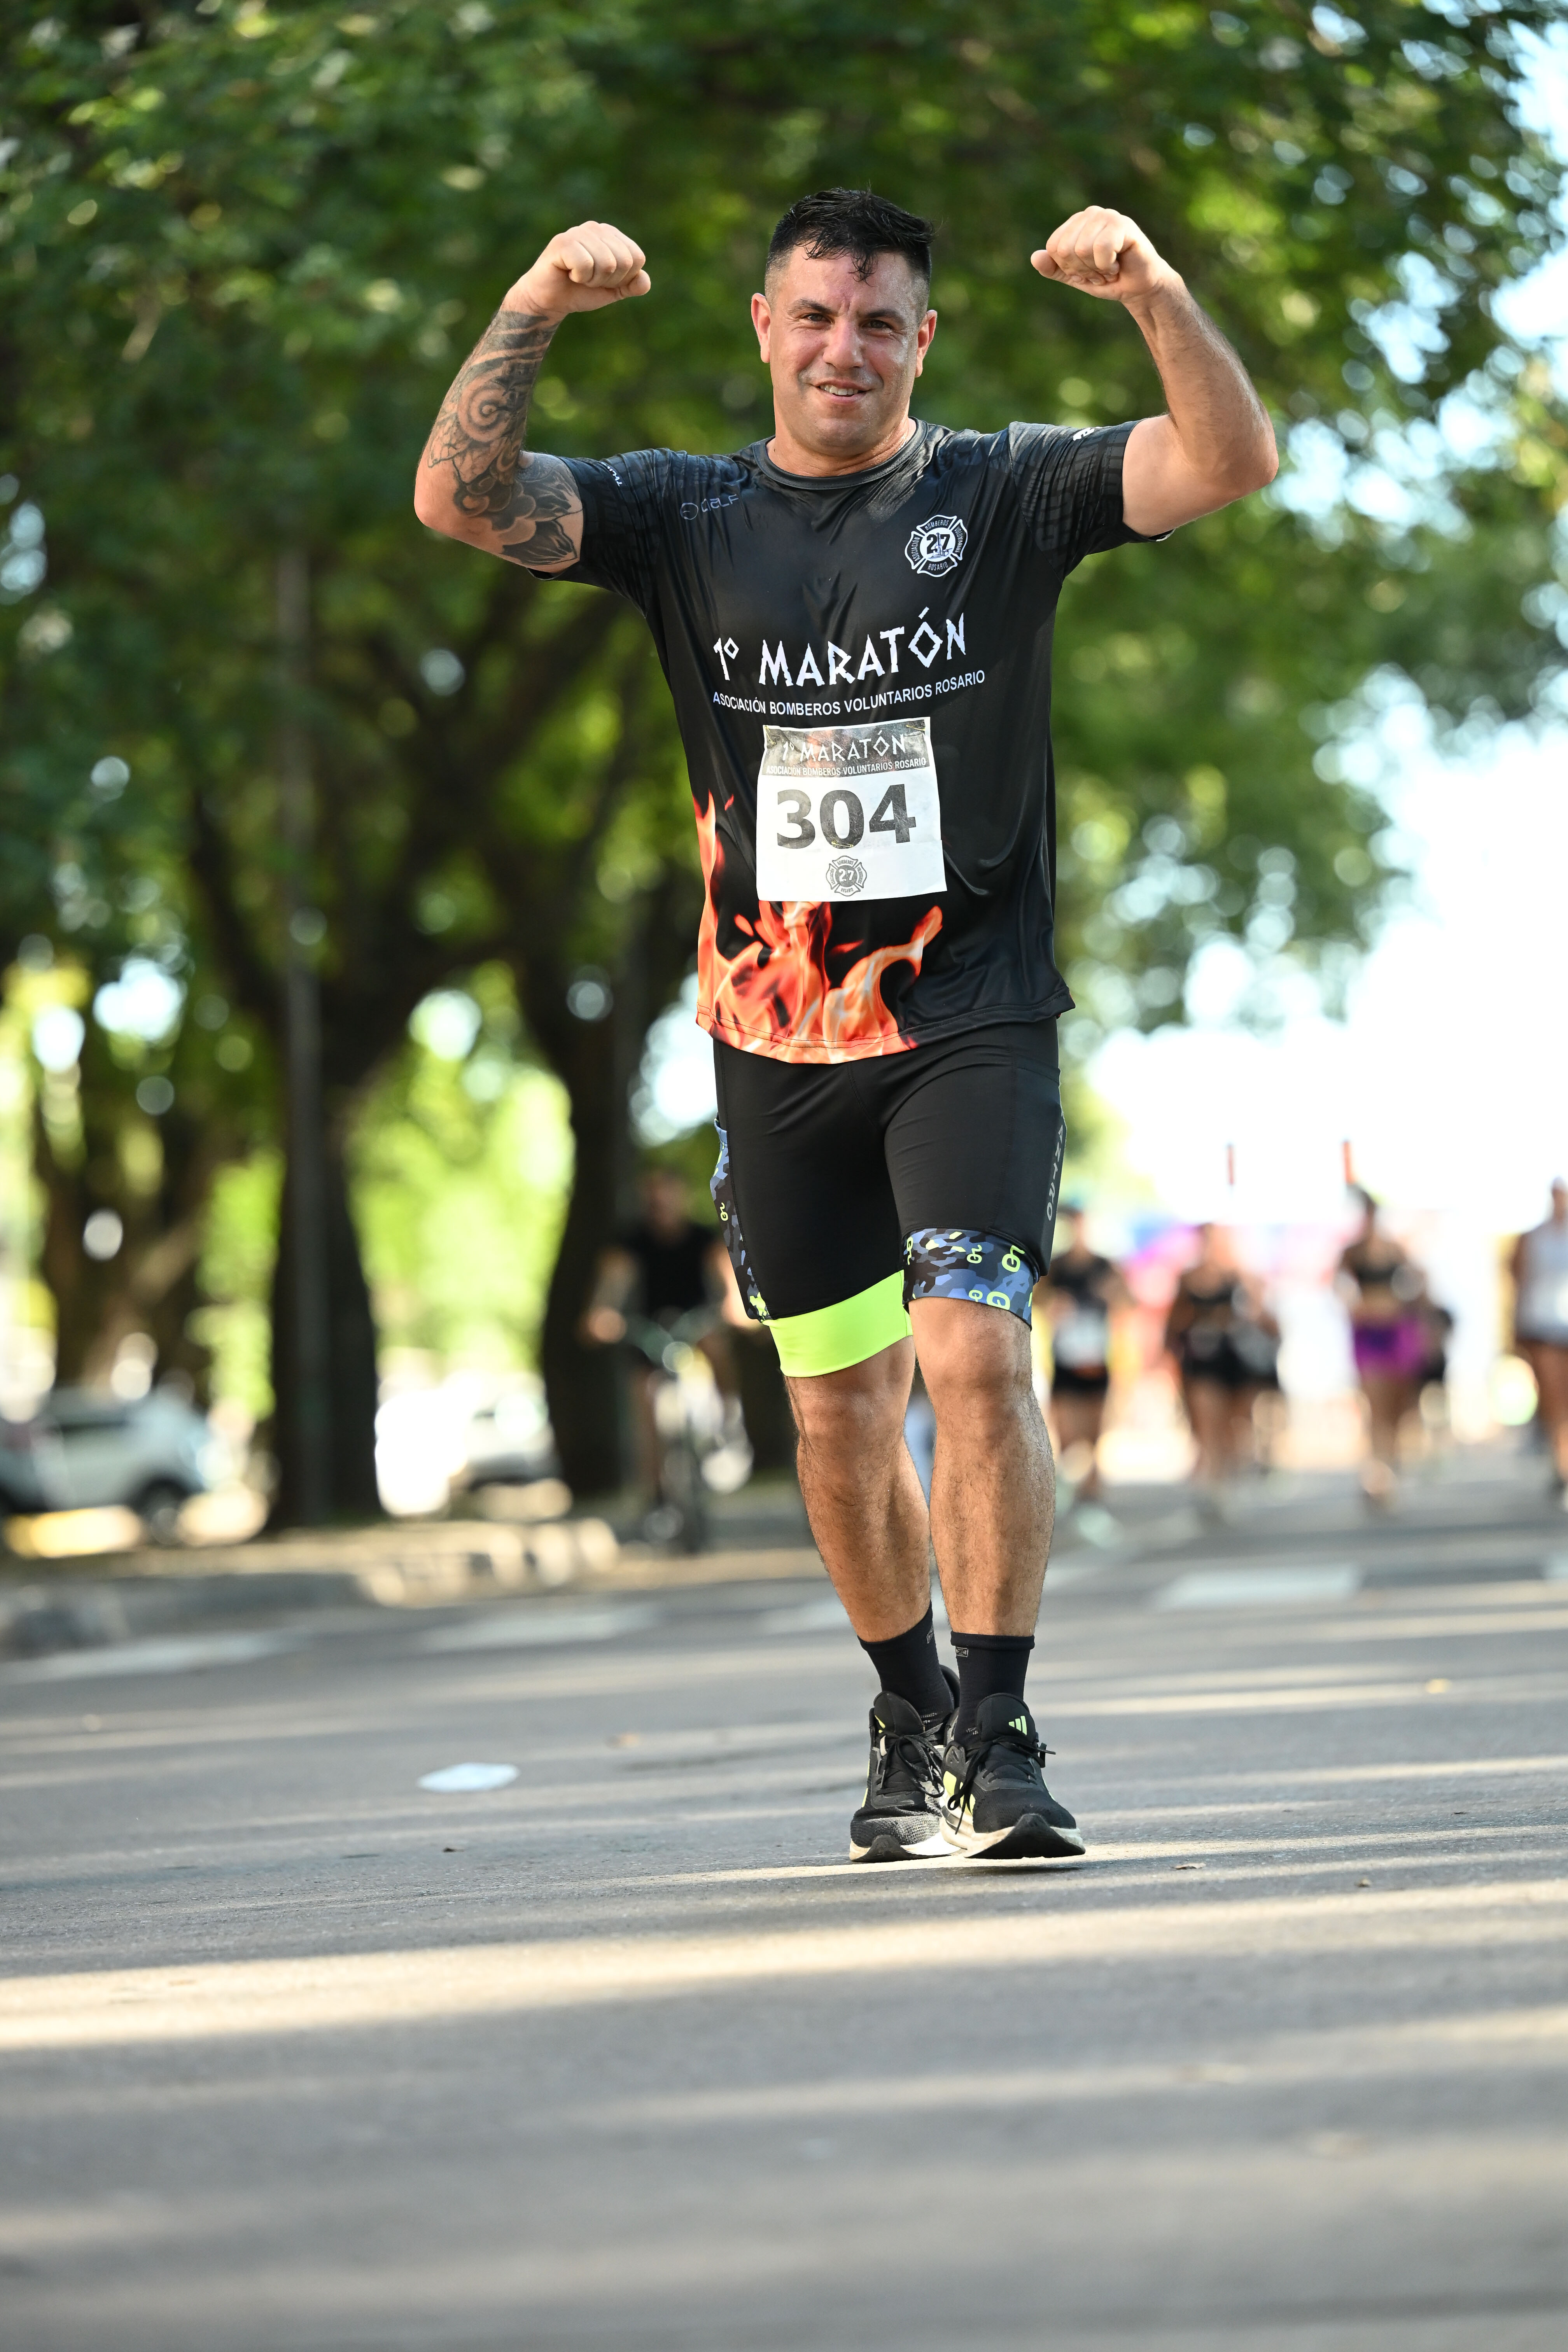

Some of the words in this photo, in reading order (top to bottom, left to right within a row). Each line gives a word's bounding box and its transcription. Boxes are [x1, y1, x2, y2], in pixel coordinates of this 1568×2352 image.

[925, 520, 949, 531] BOMBEROS
[911, 536, 921, 562] ASOCIACIÓN
[926, 534, 951, 555] 27
[927, 562, 948, 571] ROSARIO
[758, 606, 966, 687] MARATÓN
[712, 691, 766, 714] ASOCIACIÓN
[770, 701, 841, 716] BOMBEROS
[844, 683, 933, 713] VOLUNTARIOS
[934, 669, 986, 695] ROSARIO
[800, 730, 906, 762] MARATÓN
[766, 764, 801, 775] ASOCIACIÓN
[803, 766, 841, 776] BOMBEROS
[843, 761, 893, 775] VOLUNTARIOS
[894, 757, 927, 770] ROSARIO
[776, 783, 917, 849] 304
[838, 868, 854, 882] 27
[1046, 1113, 1064, 1221] ANTRO
